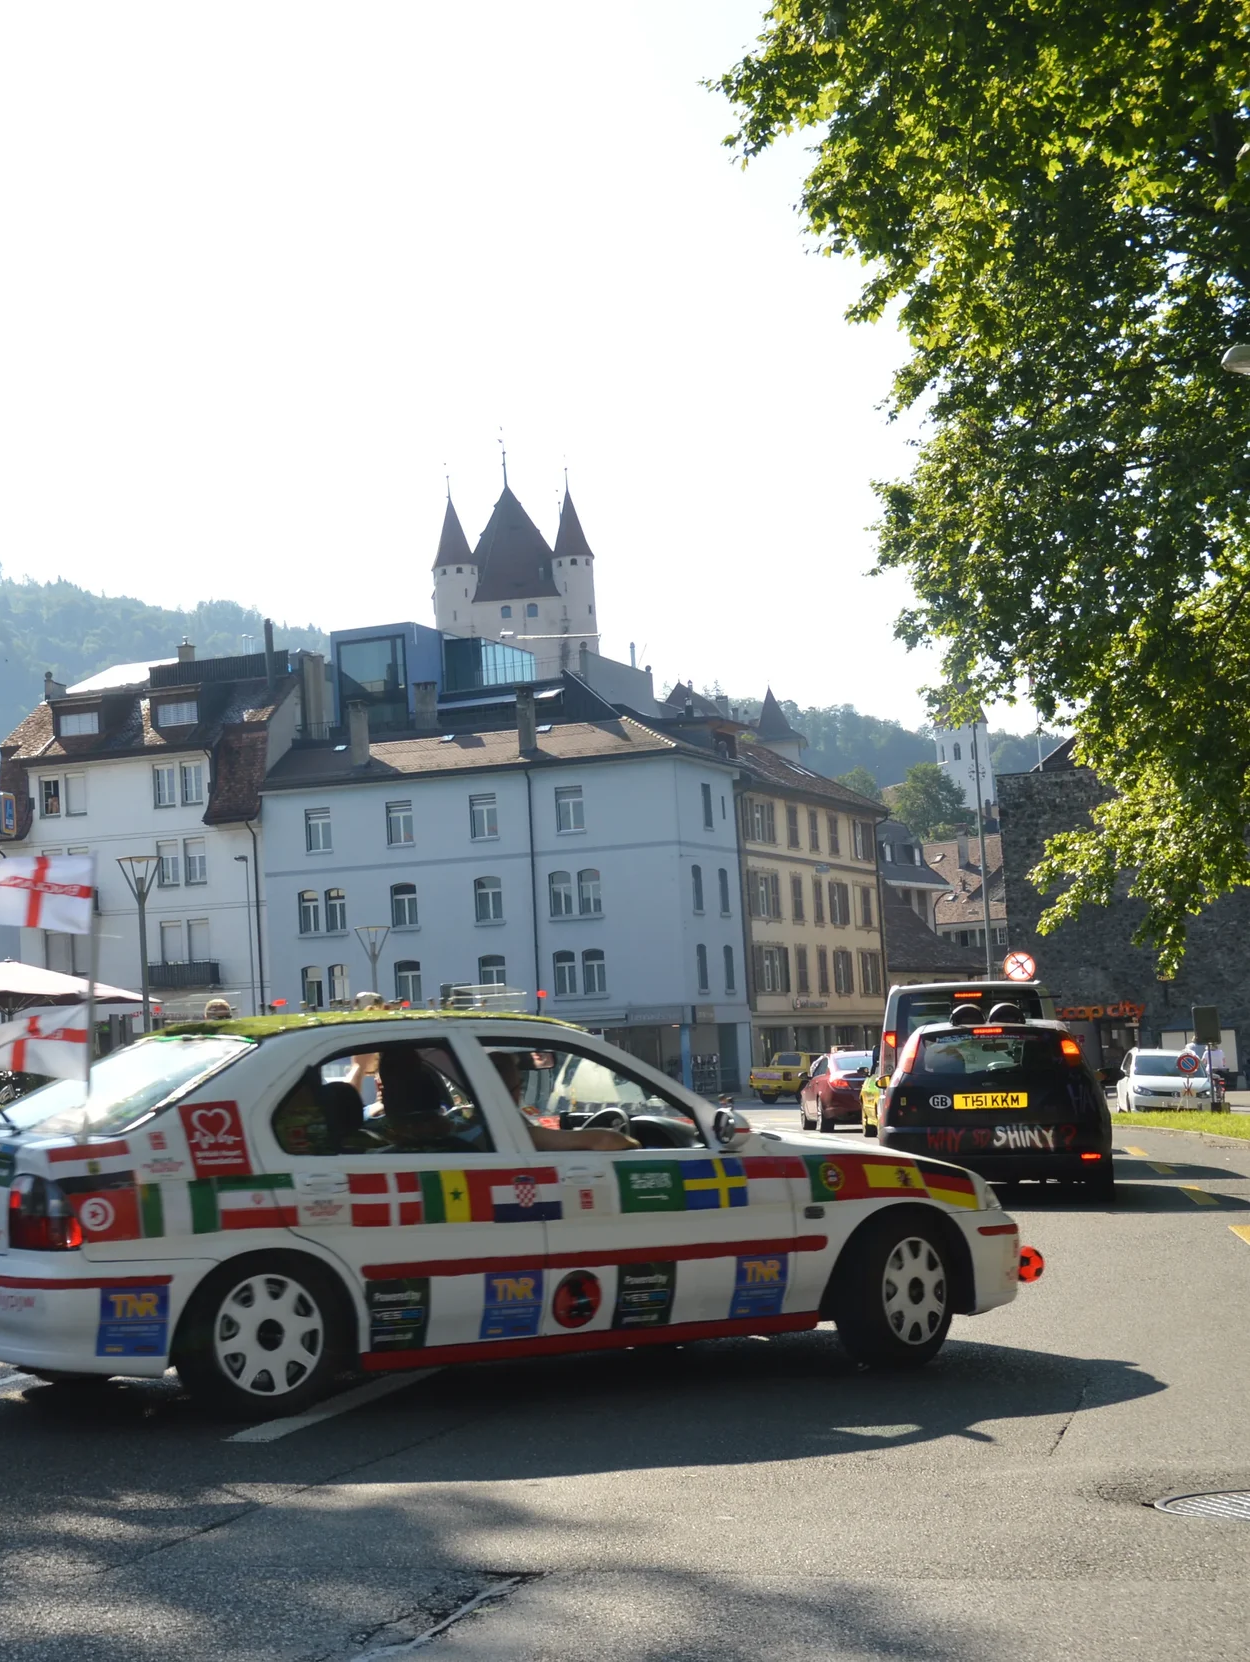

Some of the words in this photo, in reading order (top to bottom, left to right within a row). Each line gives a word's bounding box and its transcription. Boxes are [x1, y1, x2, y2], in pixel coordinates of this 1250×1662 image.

[1055, 1003, 1104, 1022] coop
[1106, 999, 1145, 1021] city
[932, 1096, 948, 1107] GB
[991, 1094, 1020, 1107] KKM
[927, 1126, 966, 1152] WHY
[993, 1124, 1055, 1152] SHINY
[624, 1274, 655, 1285] Powered
[655, 1274, 668, 1284] by
[742, 1260, 780, 1283] TNR
[373, 1291, 409, 1302] Powered
[409, 1290, 422, 1302] by
[492, 1277, 535, 1302] TNR
[109, 1292, 159, 1318] TNR
